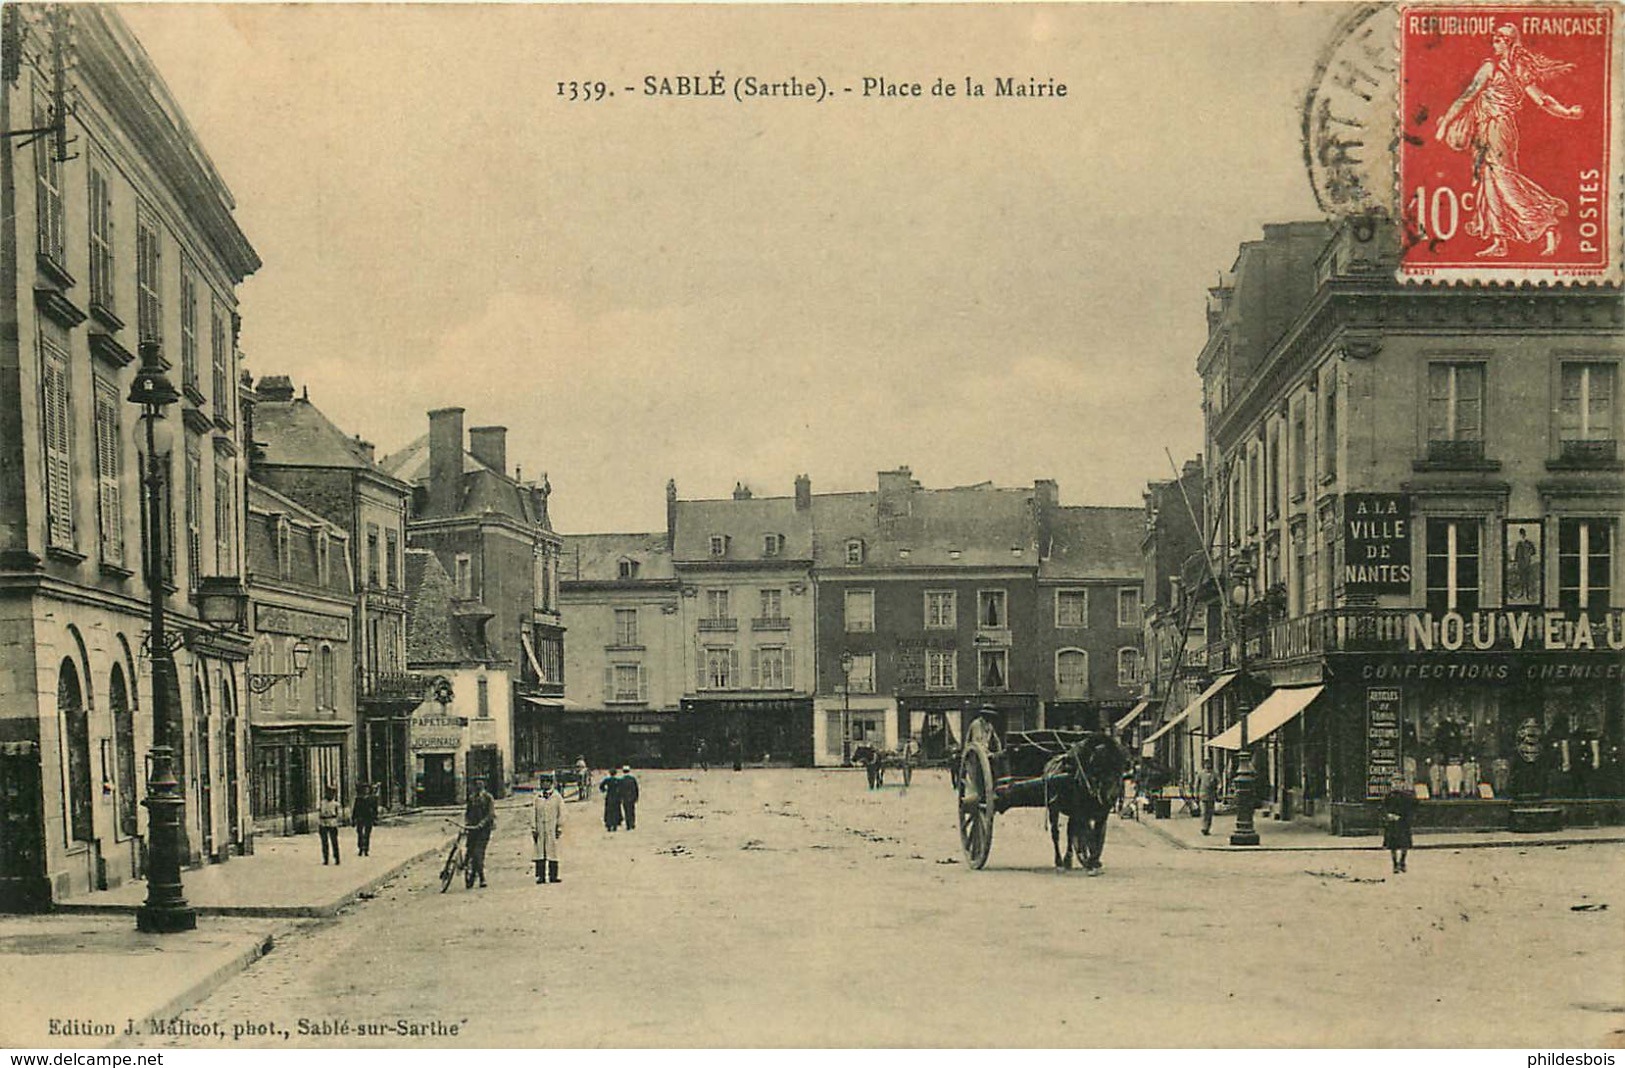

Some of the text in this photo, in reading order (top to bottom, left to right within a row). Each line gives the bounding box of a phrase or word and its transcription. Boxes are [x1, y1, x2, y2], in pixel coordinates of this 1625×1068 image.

[1522, 16, 1604, 37] FRANÇAISE
[1579, 168, 1600, 254] POSTES
[1356, 500, 1398, 515] A LA
[1350, 520, 1406, 540] VILLE
[1365, 544, 1391, 559] DE
[1345, 564, 1412, 583] NANTES
[1407, 611, 1625, 651] NOUVEAU
[1361, 663, 1509, 680] CONFECTIONS
[411, 736, 461, 747] JOURNAUX
